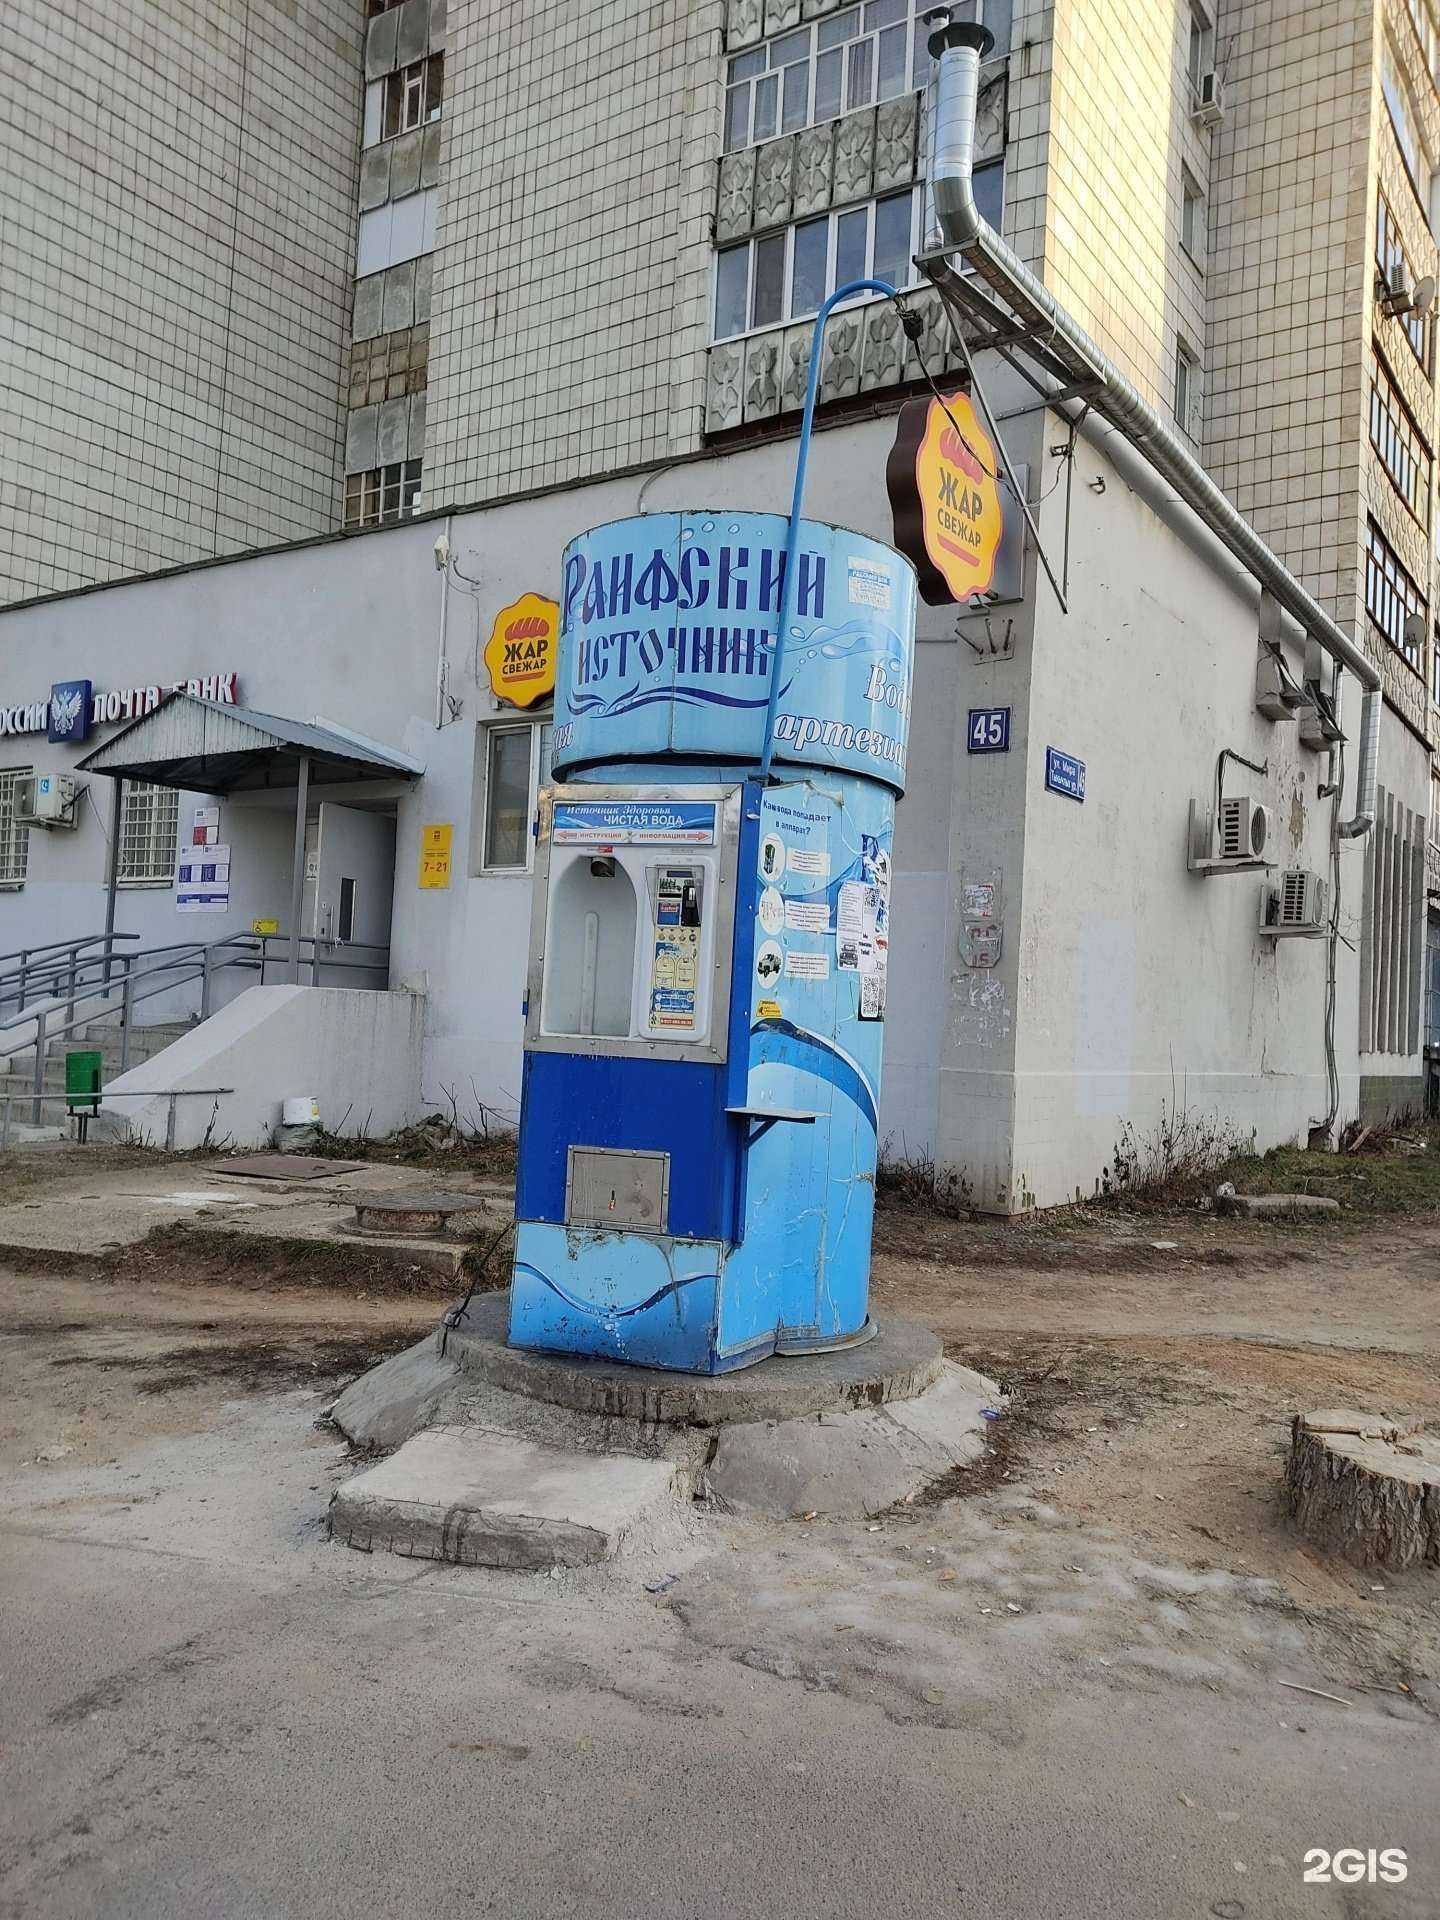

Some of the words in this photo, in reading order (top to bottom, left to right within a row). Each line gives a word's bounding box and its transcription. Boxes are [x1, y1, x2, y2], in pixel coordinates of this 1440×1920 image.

[938, 467, 983, 523] ЖАР
[937, 508, 982, 548] СВЕЖАР
[503, 640, 549, 662] ЖАР
[502, 659, 547, 674] СВЕЖАР
[93, 686, 162, 723] ПОЧТА
[973, 713, 1003, 745] 45
[566, 805, 620, 815] Источник
[622, 805, 672, 817] Здоровья
[793, 809, 832, 823] попадает
[603, 815, 648, 825] ЧИСТАЯ
[651, 815, 685, 829] ВОДА
[775, 820, 780, 828] в
